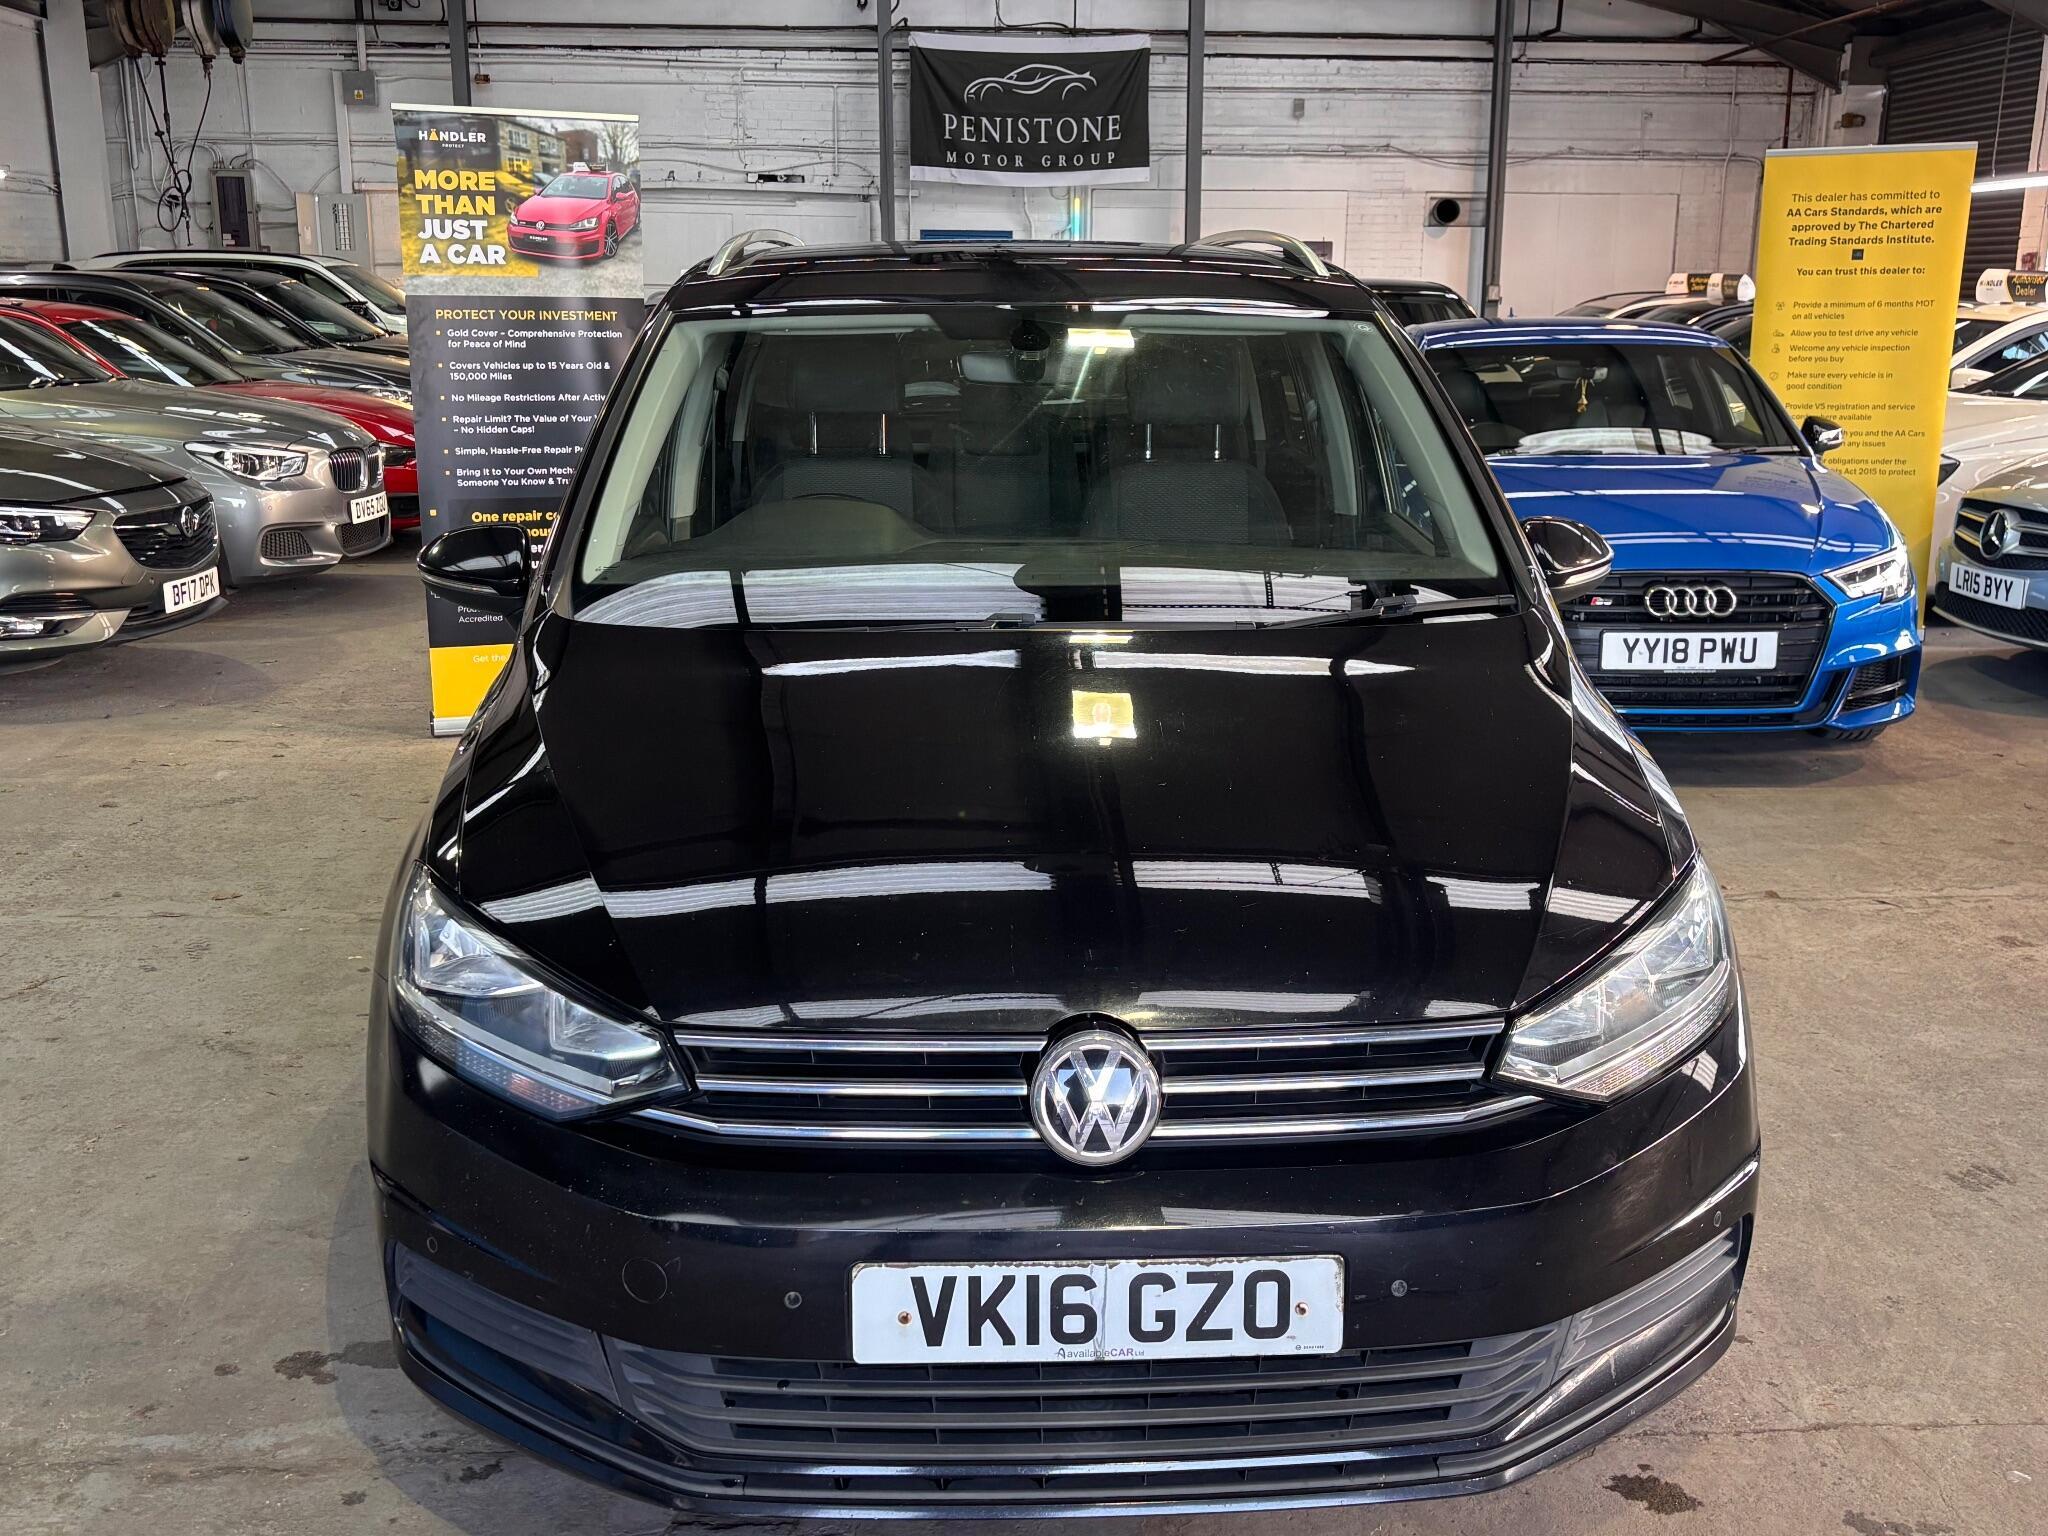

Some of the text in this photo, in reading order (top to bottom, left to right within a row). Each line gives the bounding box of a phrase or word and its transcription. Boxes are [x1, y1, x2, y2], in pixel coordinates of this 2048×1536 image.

[942, 113, 1121, 144] PENISTONE
[946, 151, 1115, 168] MOTOR GROUP
[414, 169, 496, 192] MORE
[1792, 190, 1940, 203] This dealer has committed to
[415, 194, 496, 216] THAN
[1786, 205, 1942, 217] AA Cars Standards, which are
[418, 219, 488, 240] JUST
[1791, 220, 1934, 233] approved by The Chartered
[1788, 235, 1935, 247] Trading Standards Institute.
[419, 244, 506, 265] A CAR
[1796, 267, 1926, 276] You can trust this dealer to:
[2016, 285, 2036, 296] Dealer
[1793, 301, 1822, 309] Provide
[1884, 300, 1914, 308] months
[435, 309, 618, 321] PROTECT YOUR INVESTMENT
[447, 328, 622, 339] Gold Cover Comprehensive Protection
[1790, 329, 1812, 337] Allow
[1854, 329, 1874, 337] drive
[1875, 330, 1889, 338] any
[448, 340, 526, 348] for Peace of Mind
[1789, 344, 1825, 352] Welcome
[1870, 344, 1911, 352] inspection
[1829, 355, 1844, 363] buy
[449, 361, 611, 371] Covers Vehicles up to 15 Years Old &
[449, 372, 513, 381] 150,000 Miles
[1787, 371, 1808, 379] Make
[1827, 372, 1848, 380] every
[1849, 371, 1876, 379] vehicle
[1786, 383, 1805, 391] good
[467, 394, 501, 403] Mileage
[558, 393, 580, 401] After
[583, 393, 606, 401] Activ
[1785, 402, 1813, 410] Provide
[1827, 403, 1870, 411] registration
[453, 415, 482, 424] Repair
[485, 415, 511, 423] Limit?
[532, 414, 558, 422] Value
[559, 414, 569, 422] of
[460, 425, 535, 434] No Hidden Caps!
[455, 446, 488, 456] Simple,
[490, 446, 542, 455] Hassle-Free
[543, 446, 572, 455] Repair
[1828, 457, 1869, 465] obligations
[456, 468, 481, 477] Bring
[550, 467, 574, 475] Mech
[1888, 468, 1916, 476] protect
[457, 479, 499, 487] Someone
[501, 478, 519, 486] You
[521, 478, 545, 486] Know
[556, 477, 569, 485] Tru
[471, 511, 499, 523] One
[502, 509, 542, 523] repair
[1955, 564, 2014, 601] LR15 BYY
[172, 571, 216, 607] BF17 DPK
[458, 615, 503, 623] Accredited
[1622, 637, 1758, 664] YY18 PWU
[911, 1269, 1291, 1347] VK16 GZO
